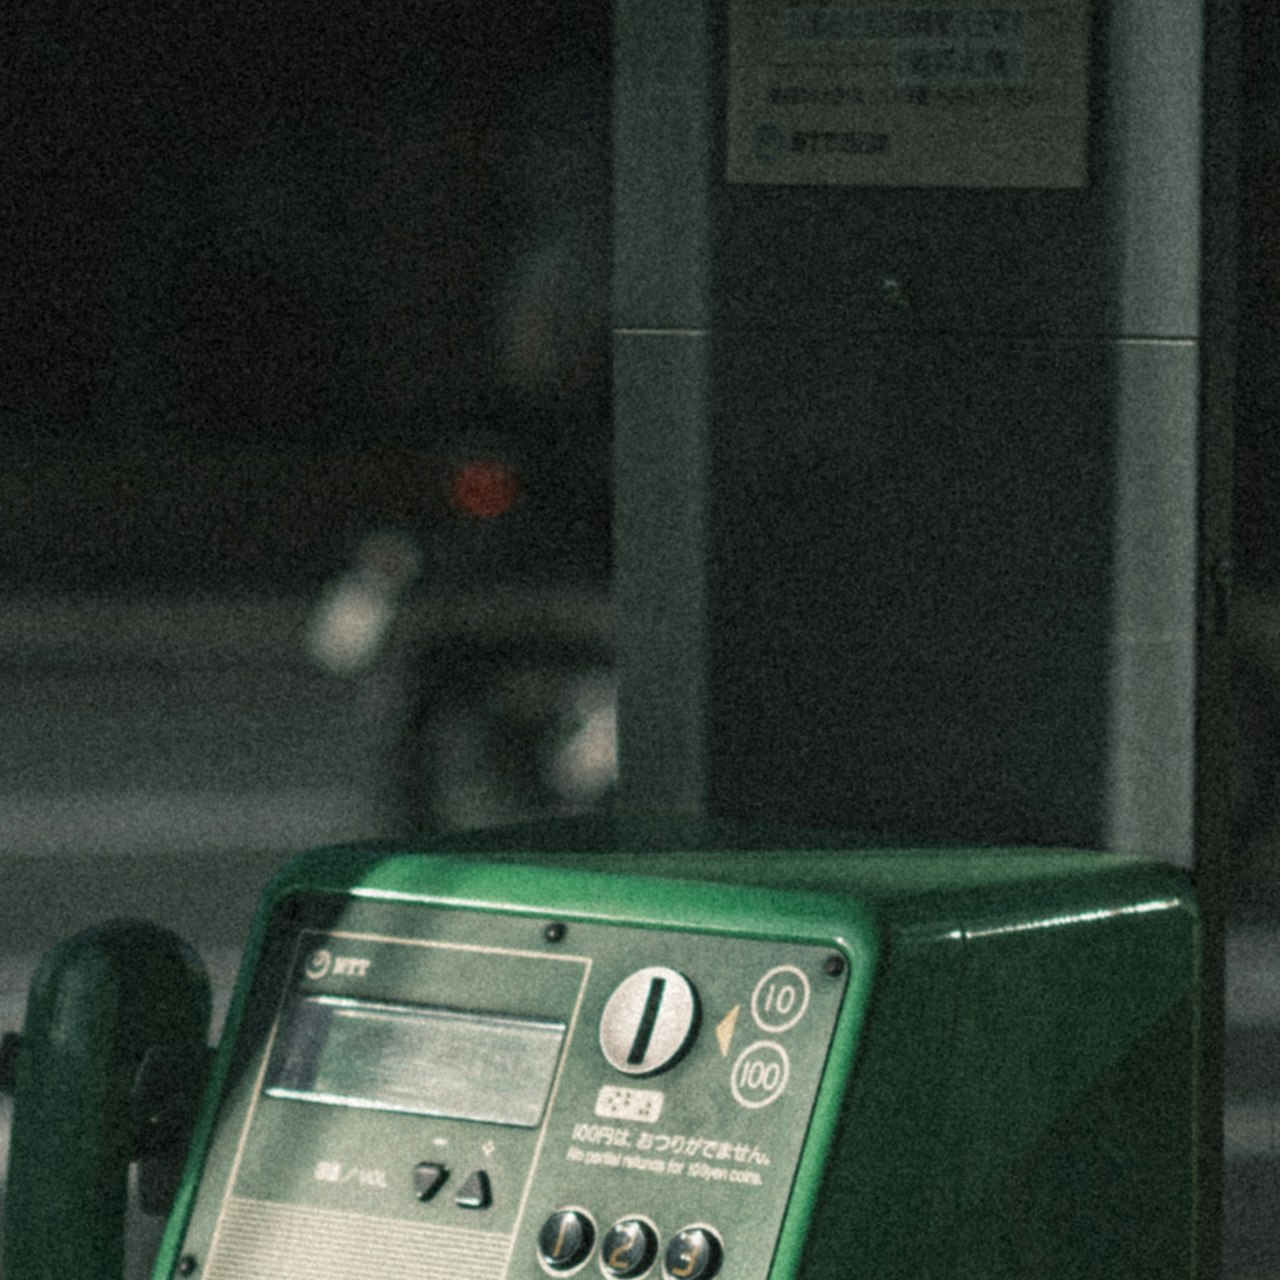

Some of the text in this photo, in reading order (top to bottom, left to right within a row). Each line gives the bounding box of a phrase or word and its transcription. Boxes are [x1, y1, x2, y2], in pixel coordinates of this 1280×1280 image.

[333, 956, 371, 977] NTT
[764, 983, 796, 1015] 10
[739, 1059, 781, 1091] 100
[566, 1146, 585, 1161] No
[585, 1149, 621, 1168] partial
[623, 1153, 665, 1173] refunds
[667, 1159, 684, 1175] for
[607, 1223, 636, 1269] 2
[671, 1231, 700, 1277] 3
